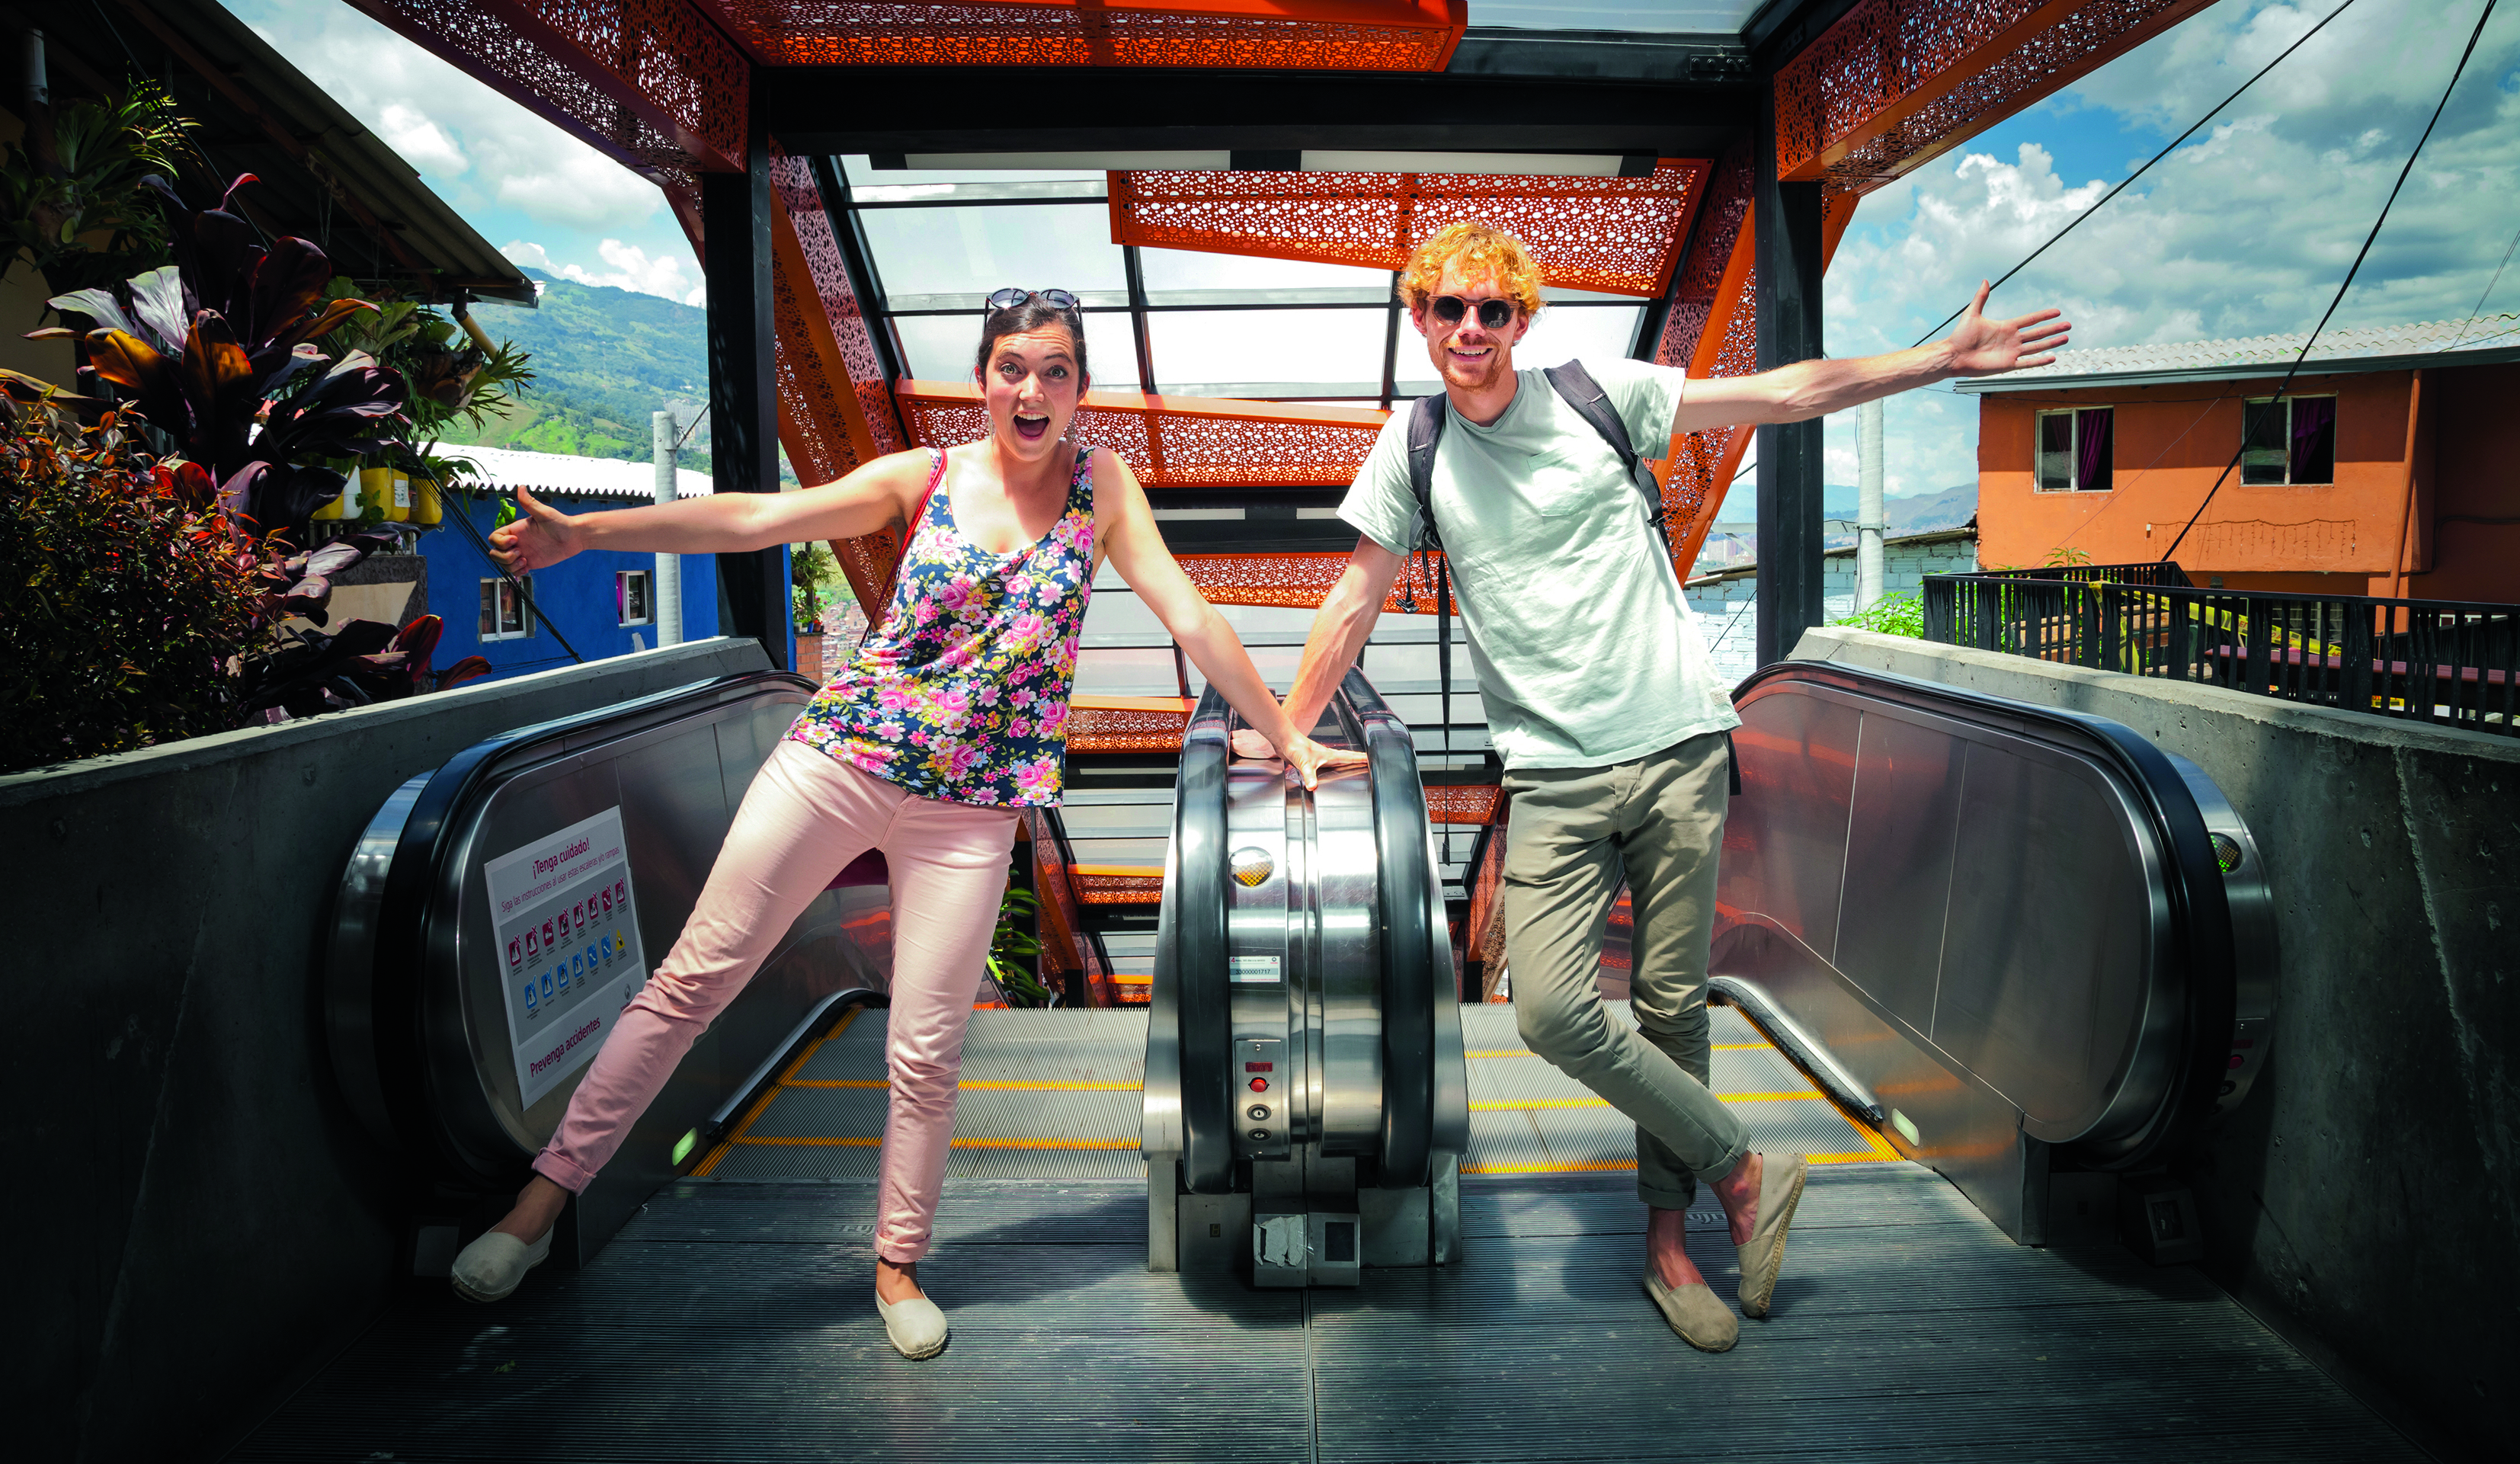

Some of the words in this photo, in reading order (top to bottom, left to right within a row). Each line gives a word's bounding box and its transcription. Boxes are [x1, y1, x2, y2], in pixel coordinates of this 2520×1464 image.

[501, 900, 513, 913] Siga
[513, 895, 521, 907] las
[521, 880, 552, 902] instrucciones
[552, 875, 557, 886] al
[557, 872, 567, 884] usar
[567, 866, 579, 879] estas
[579, 857, 598, 873] escaleras
[605, 846, 620, 860] rampas
[533, 854, 559, 879] ¡Tenga
[559, 838, 590, 863] cuidado!
[530, 1044, 565, 1078] Prevenga
[565, 1017, 600, 1051] accidentes
